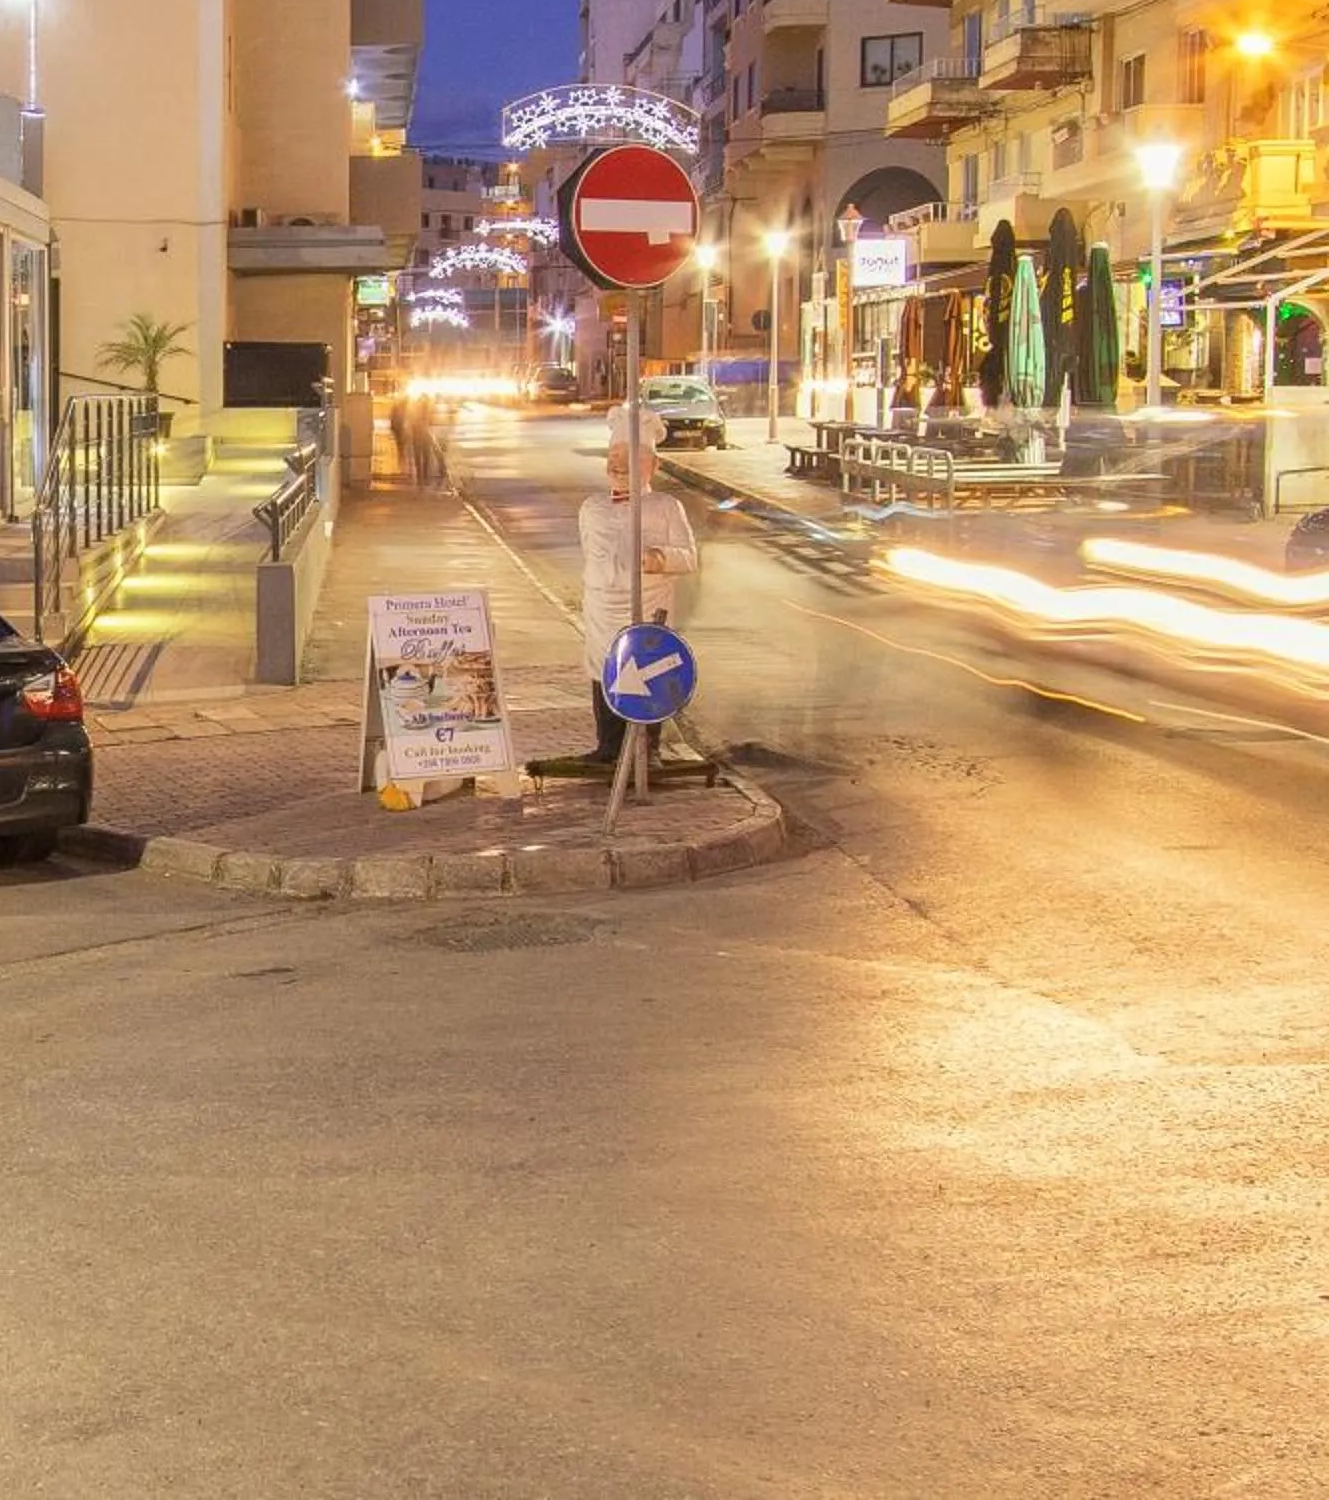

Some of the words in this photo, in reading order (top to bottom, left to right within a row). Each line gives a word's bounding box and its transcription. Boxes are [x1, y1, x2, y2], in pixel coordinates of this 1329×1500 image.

[386, 599, 432, 611] Primera
[406, 613, 448, 625] Sunday
[389, 626, 448, 638] Afternoon
[452, 623, 472, 634] Tea
[435, 727, 454, 742] €7
